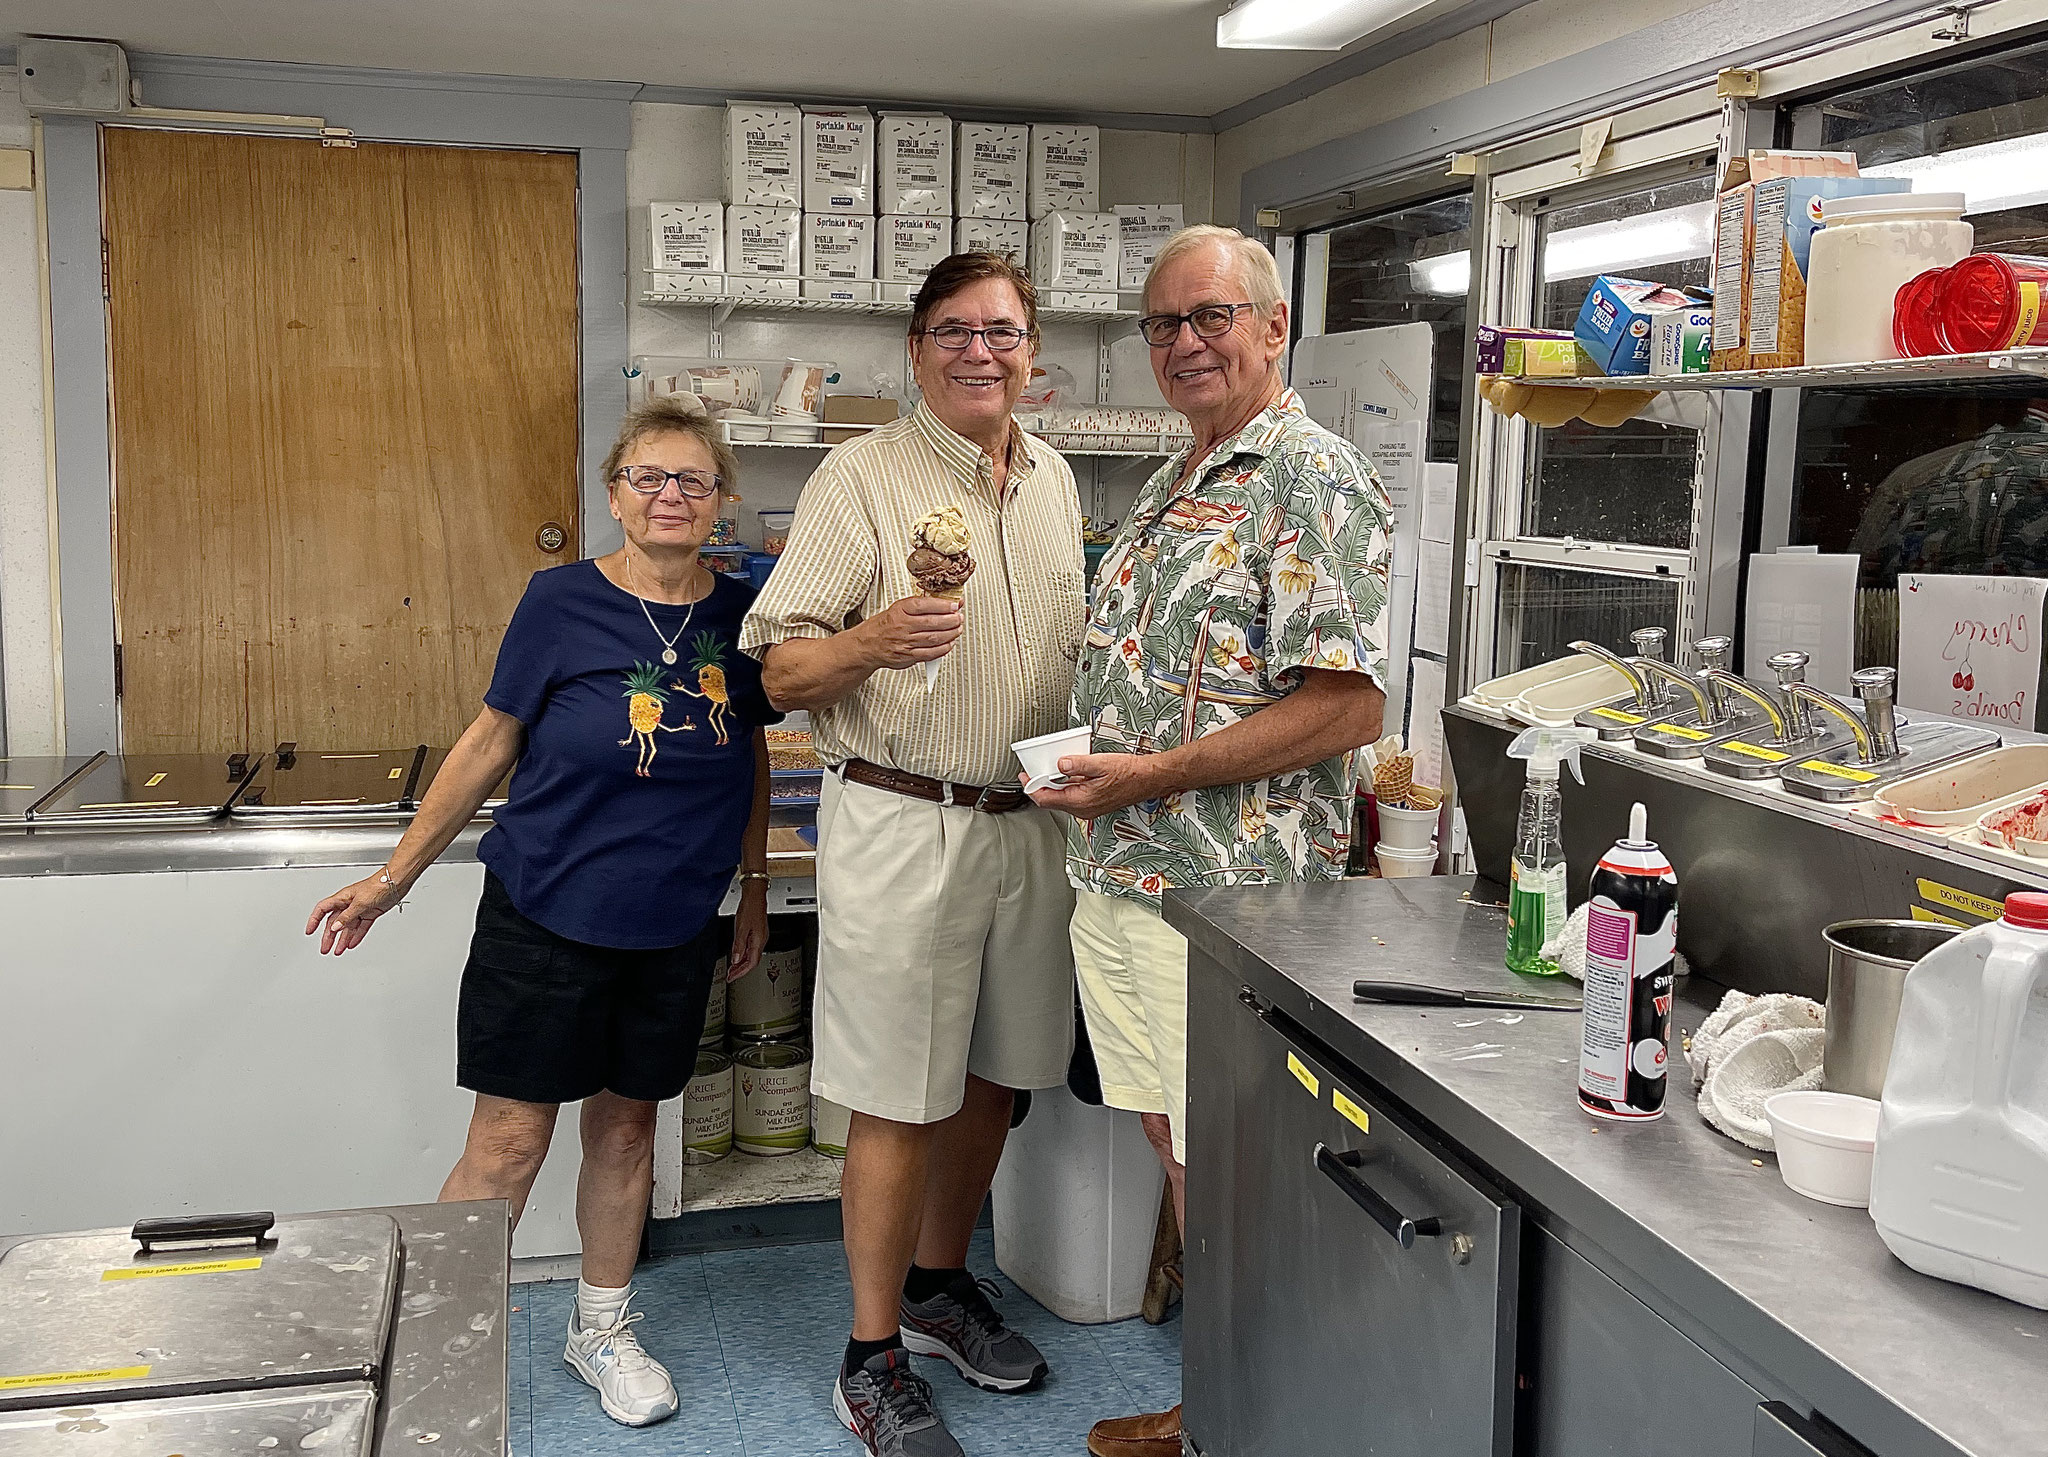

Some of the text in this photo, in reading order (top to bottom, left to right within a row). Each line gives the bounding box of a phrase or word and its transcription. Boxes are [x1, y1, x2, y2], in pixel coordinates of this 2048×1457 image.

[815, 120, 864, 133] Sprinkle King
[816, 217, 864, 231] Sprinkle King
[894, 219, 942, 231] Sprinkle King
[1590, 316, 1610, 335] BAGS
[1940, 889, 1953, 901] DO
[1953, 894, 1970, 905] NOT
[1971, 899, 1991, 912] KEEP
[766, 1076, 788, 1086] RICE
[695, 1083, 716, 1093] RICE
[754, 1108, 785, 1117] SUNDAE
[683, 1115, 714, 1125] SUNDAE
[766, 1118, 783, 1126] MILK
[784, 1112, 804, 1123] FUDGE
[694, 1117, 730, 1133] MILK FUDGE
[156, 1267, 179, 1275] swirl
[181, 1262, 228, 1272] raspberry
[28, 1375, 63, 1384] pecan
[65, 1371, 111, 1380] caramel
